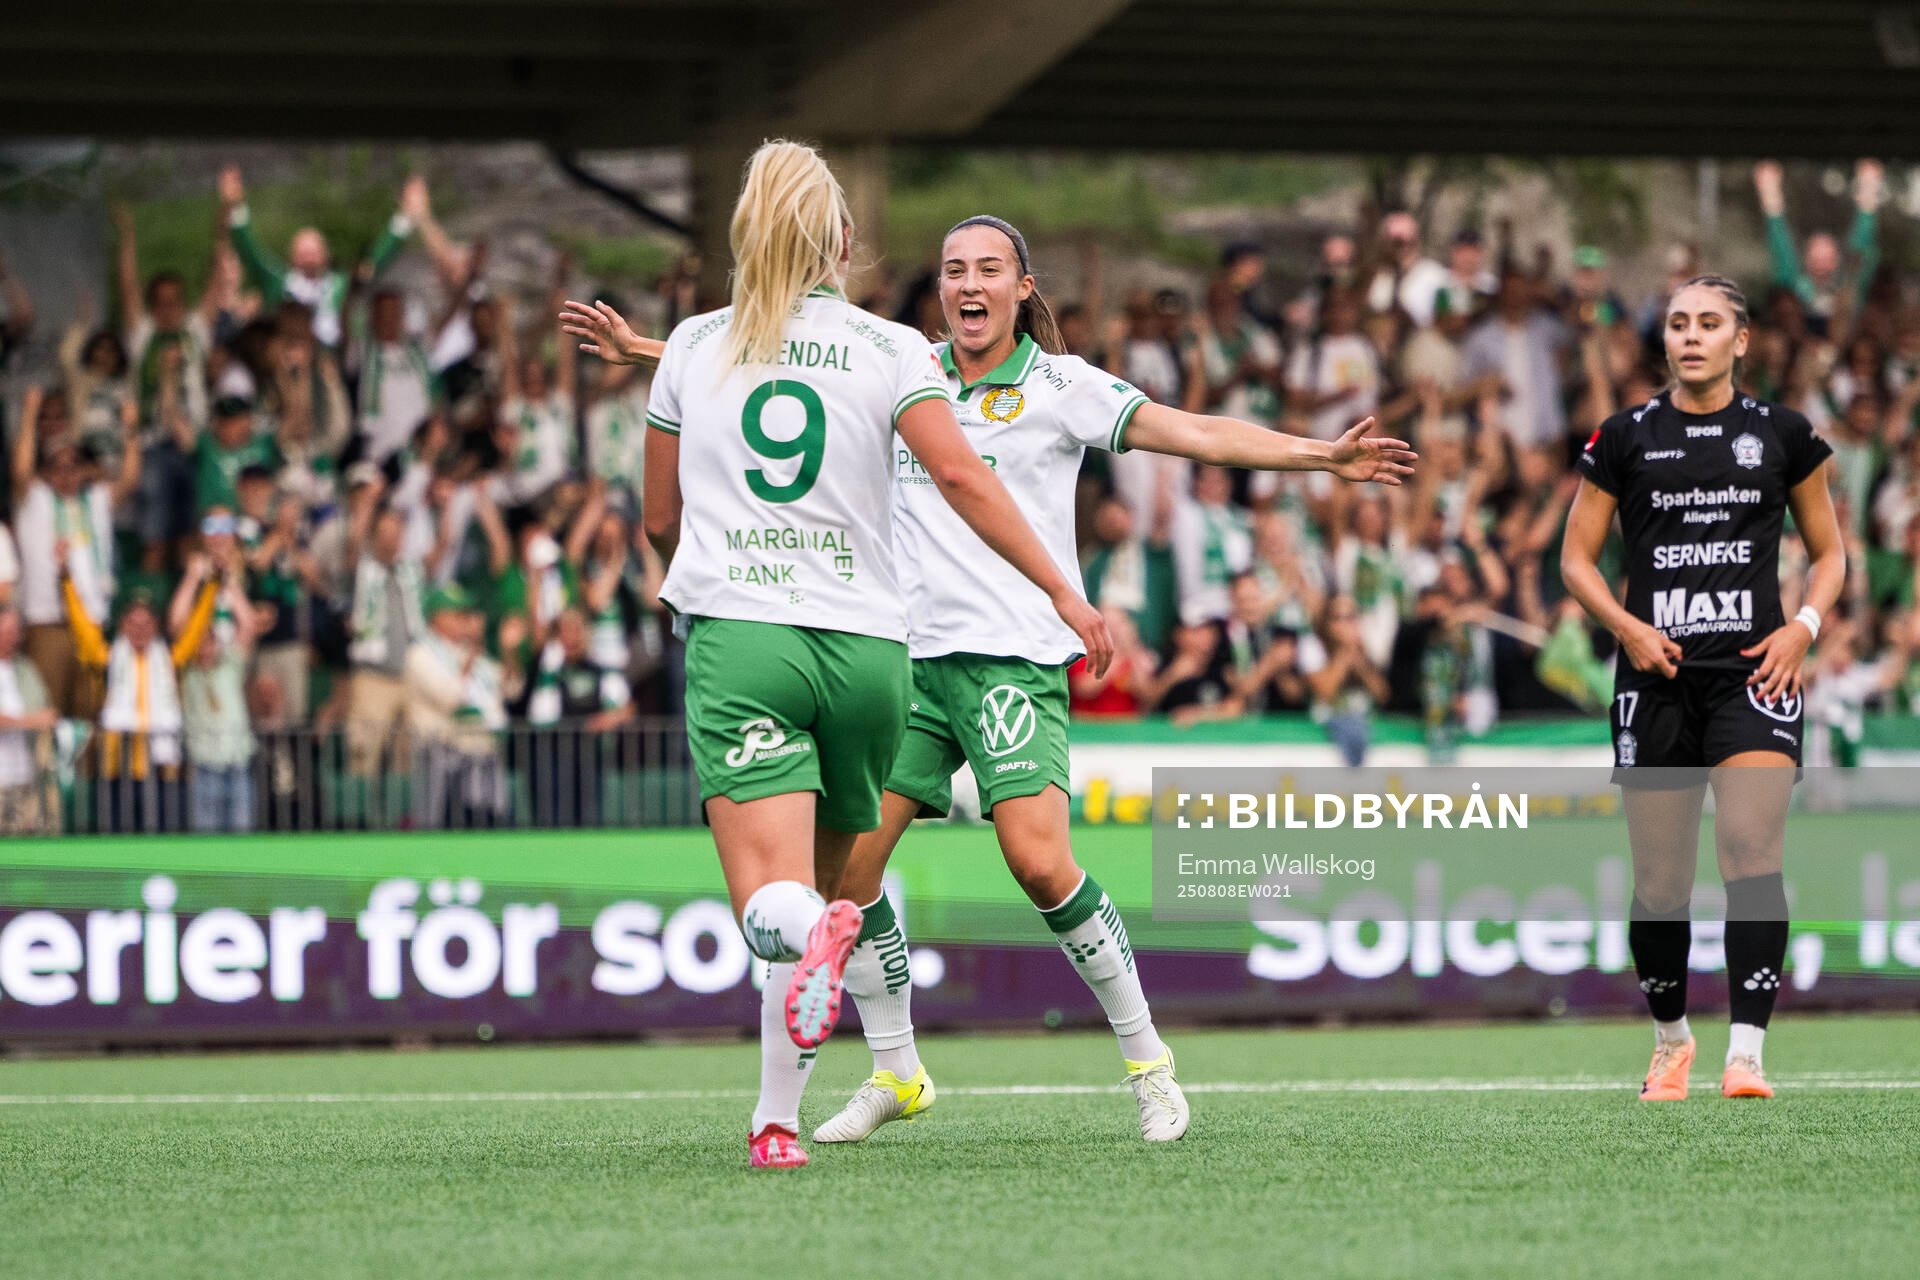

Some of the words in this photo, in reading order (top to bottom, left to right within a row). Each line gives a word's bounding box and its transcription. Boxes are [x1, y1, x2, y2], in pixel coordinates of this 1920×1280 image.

[741, 379, 826, 503] 9
[1651, 485, 1761, 511] Sparbanken
[1653, 541, 1751, 569] SERNEKE
[728, 564, 798, 586] BANK
[1653, 588, 1752, 628] MAXI
[1617, 692, 1638, 727] 17
[995, 761, 1028, 773] CRAFT
[356, 876, 560, 999] för
